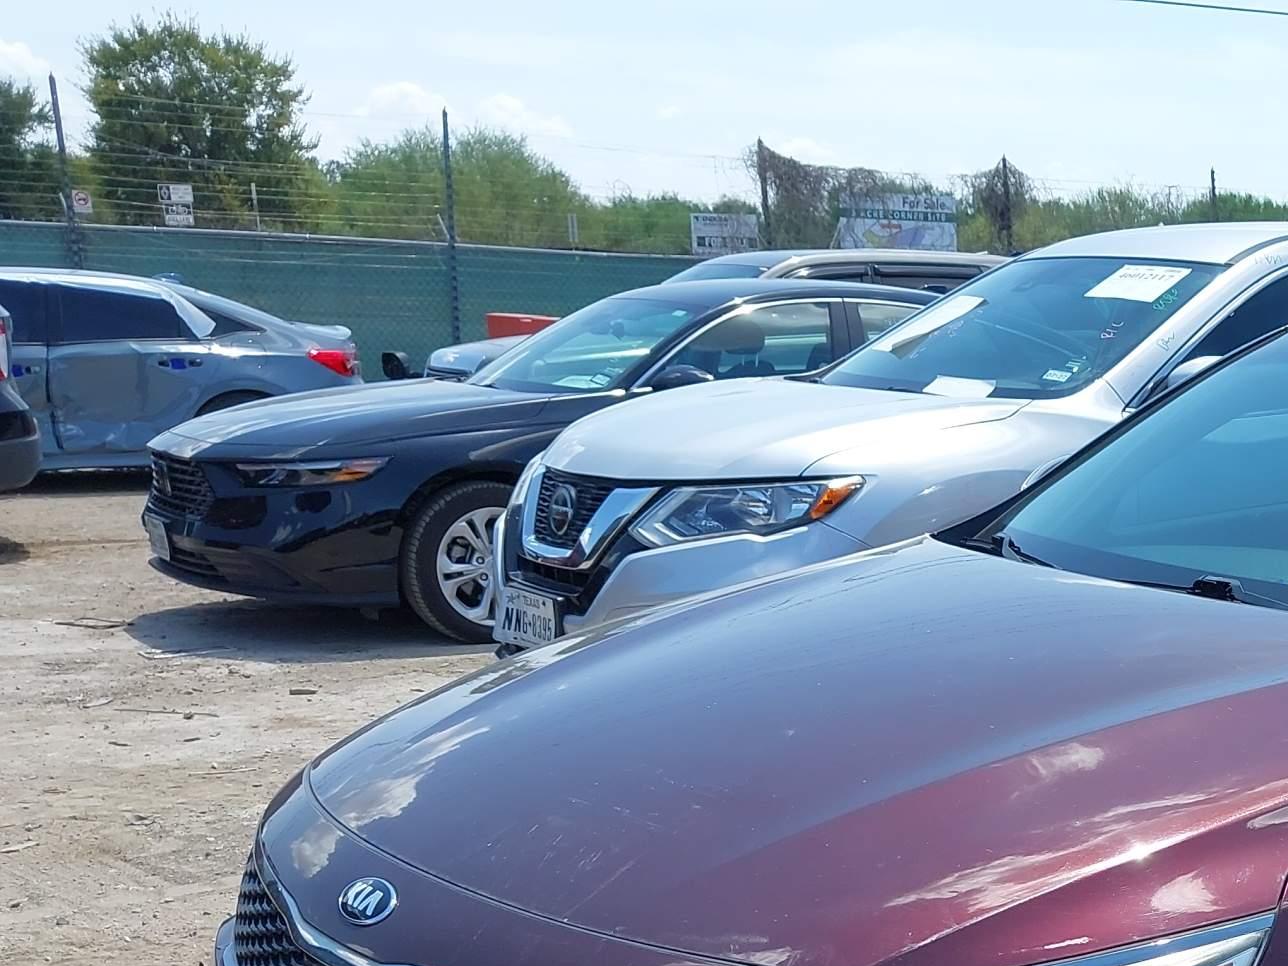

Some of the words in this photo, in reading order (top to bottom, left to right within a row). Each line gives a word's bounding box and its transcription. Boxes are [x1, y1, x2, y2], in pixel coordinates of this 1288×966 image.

[902, 197, 920, 209] For
[923, 198, 946, 210] Sale
[347, 881, 384, 916] KIA
